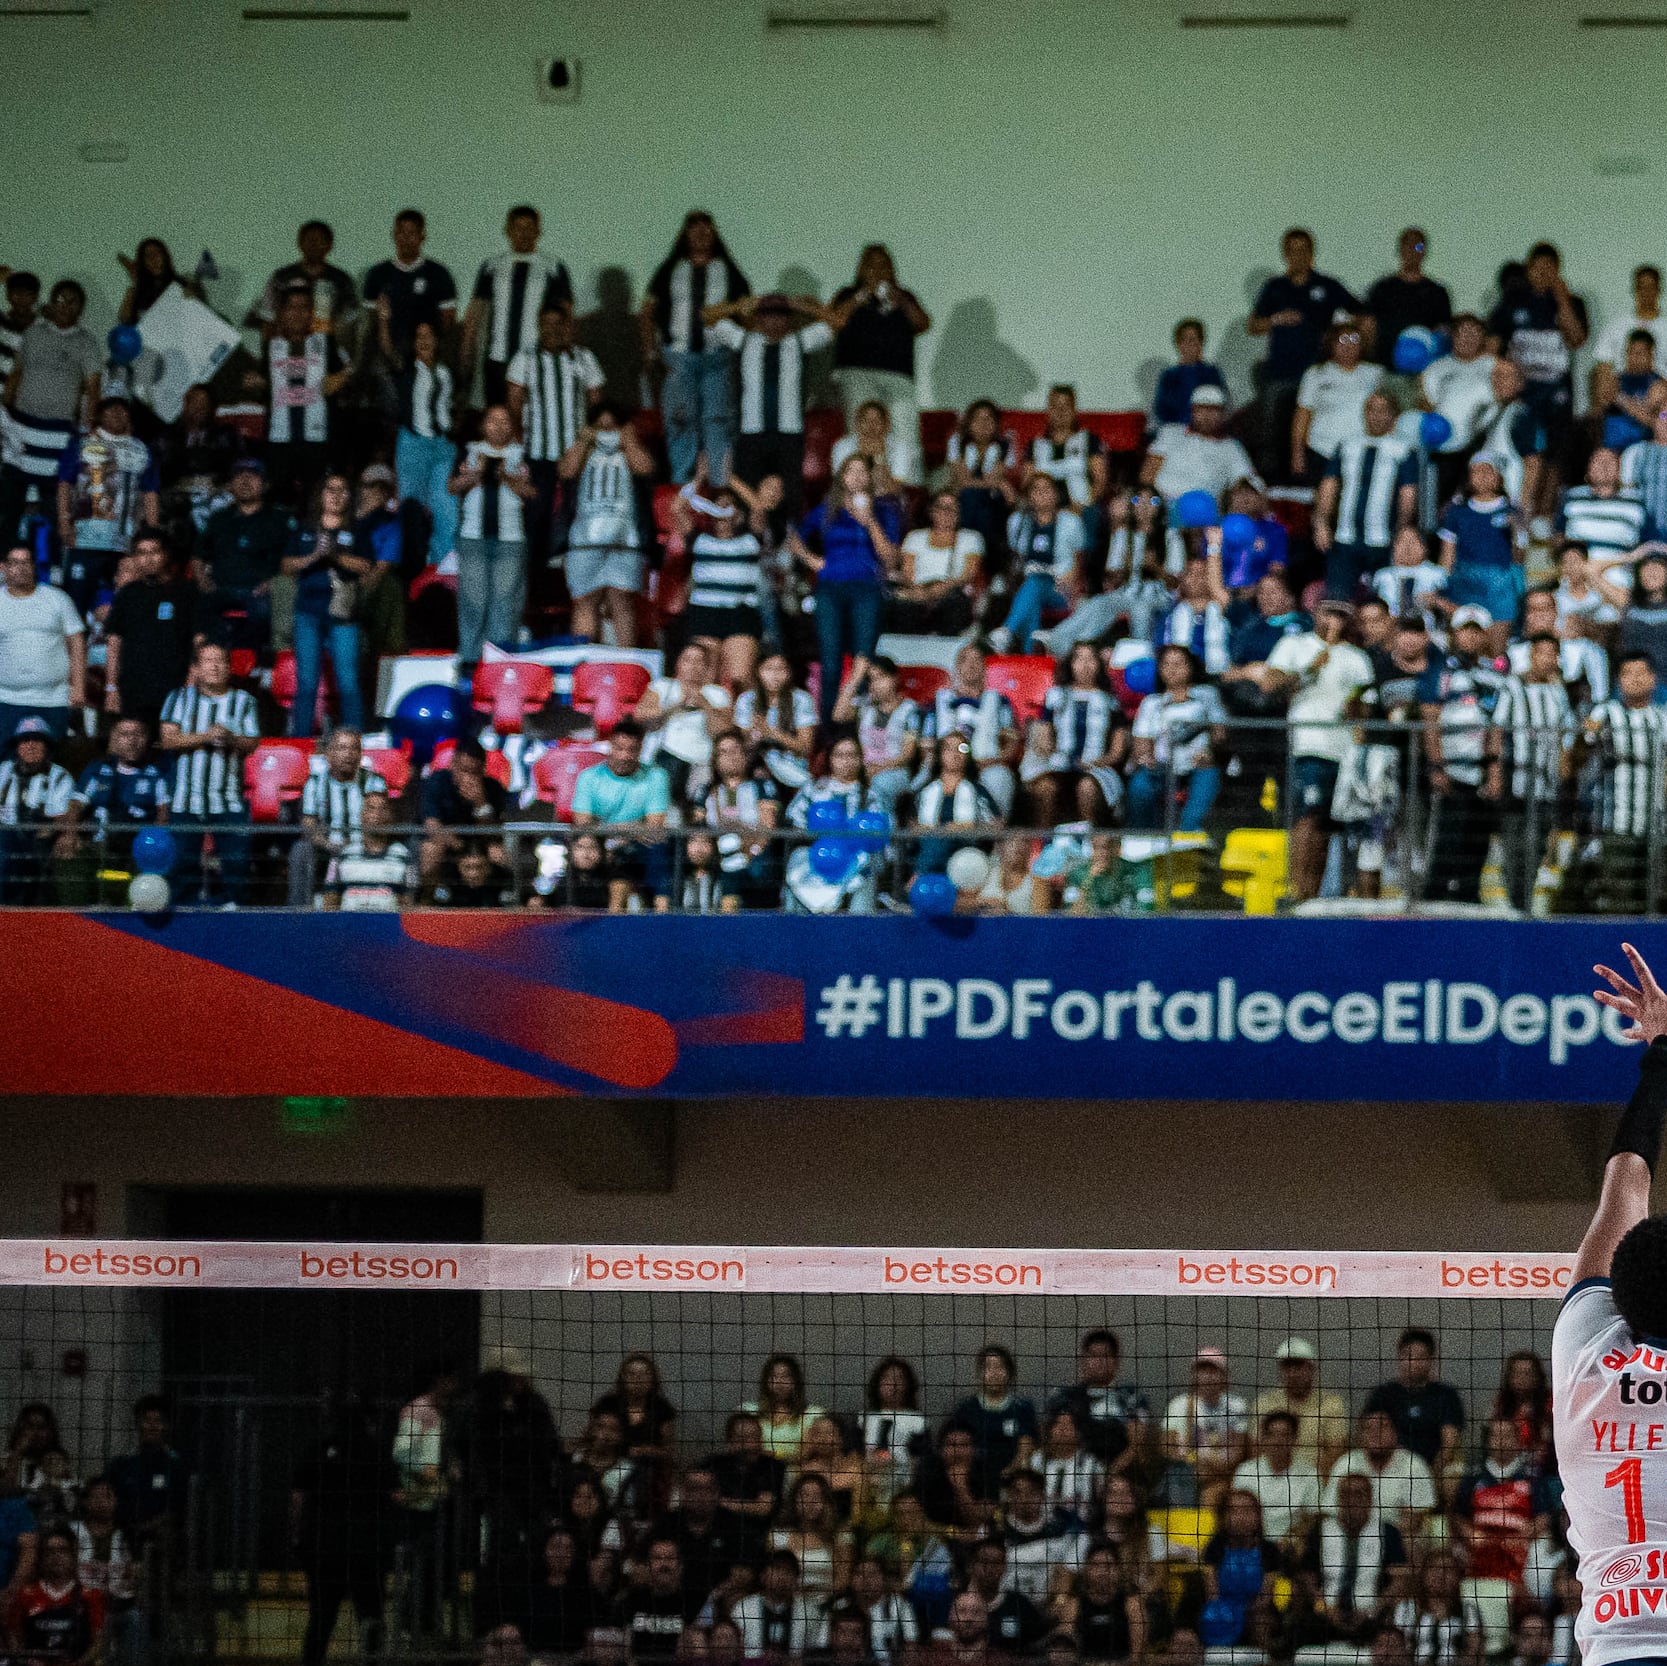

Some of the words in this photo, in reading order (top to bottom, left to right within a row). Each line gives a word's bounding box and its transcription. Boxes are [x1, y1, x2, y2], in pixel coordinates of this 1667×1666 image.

[45, 1247, 202, 1280] betsson
[301, 1250, 458, 1281] betsson
[586, 1252, 745, 1284] betsson
[884, 1256, 1043, 1287] betsson
[1178, 1258, 1337, 1289] betsson
[1441, 1260, 1572, 1288] betsso
